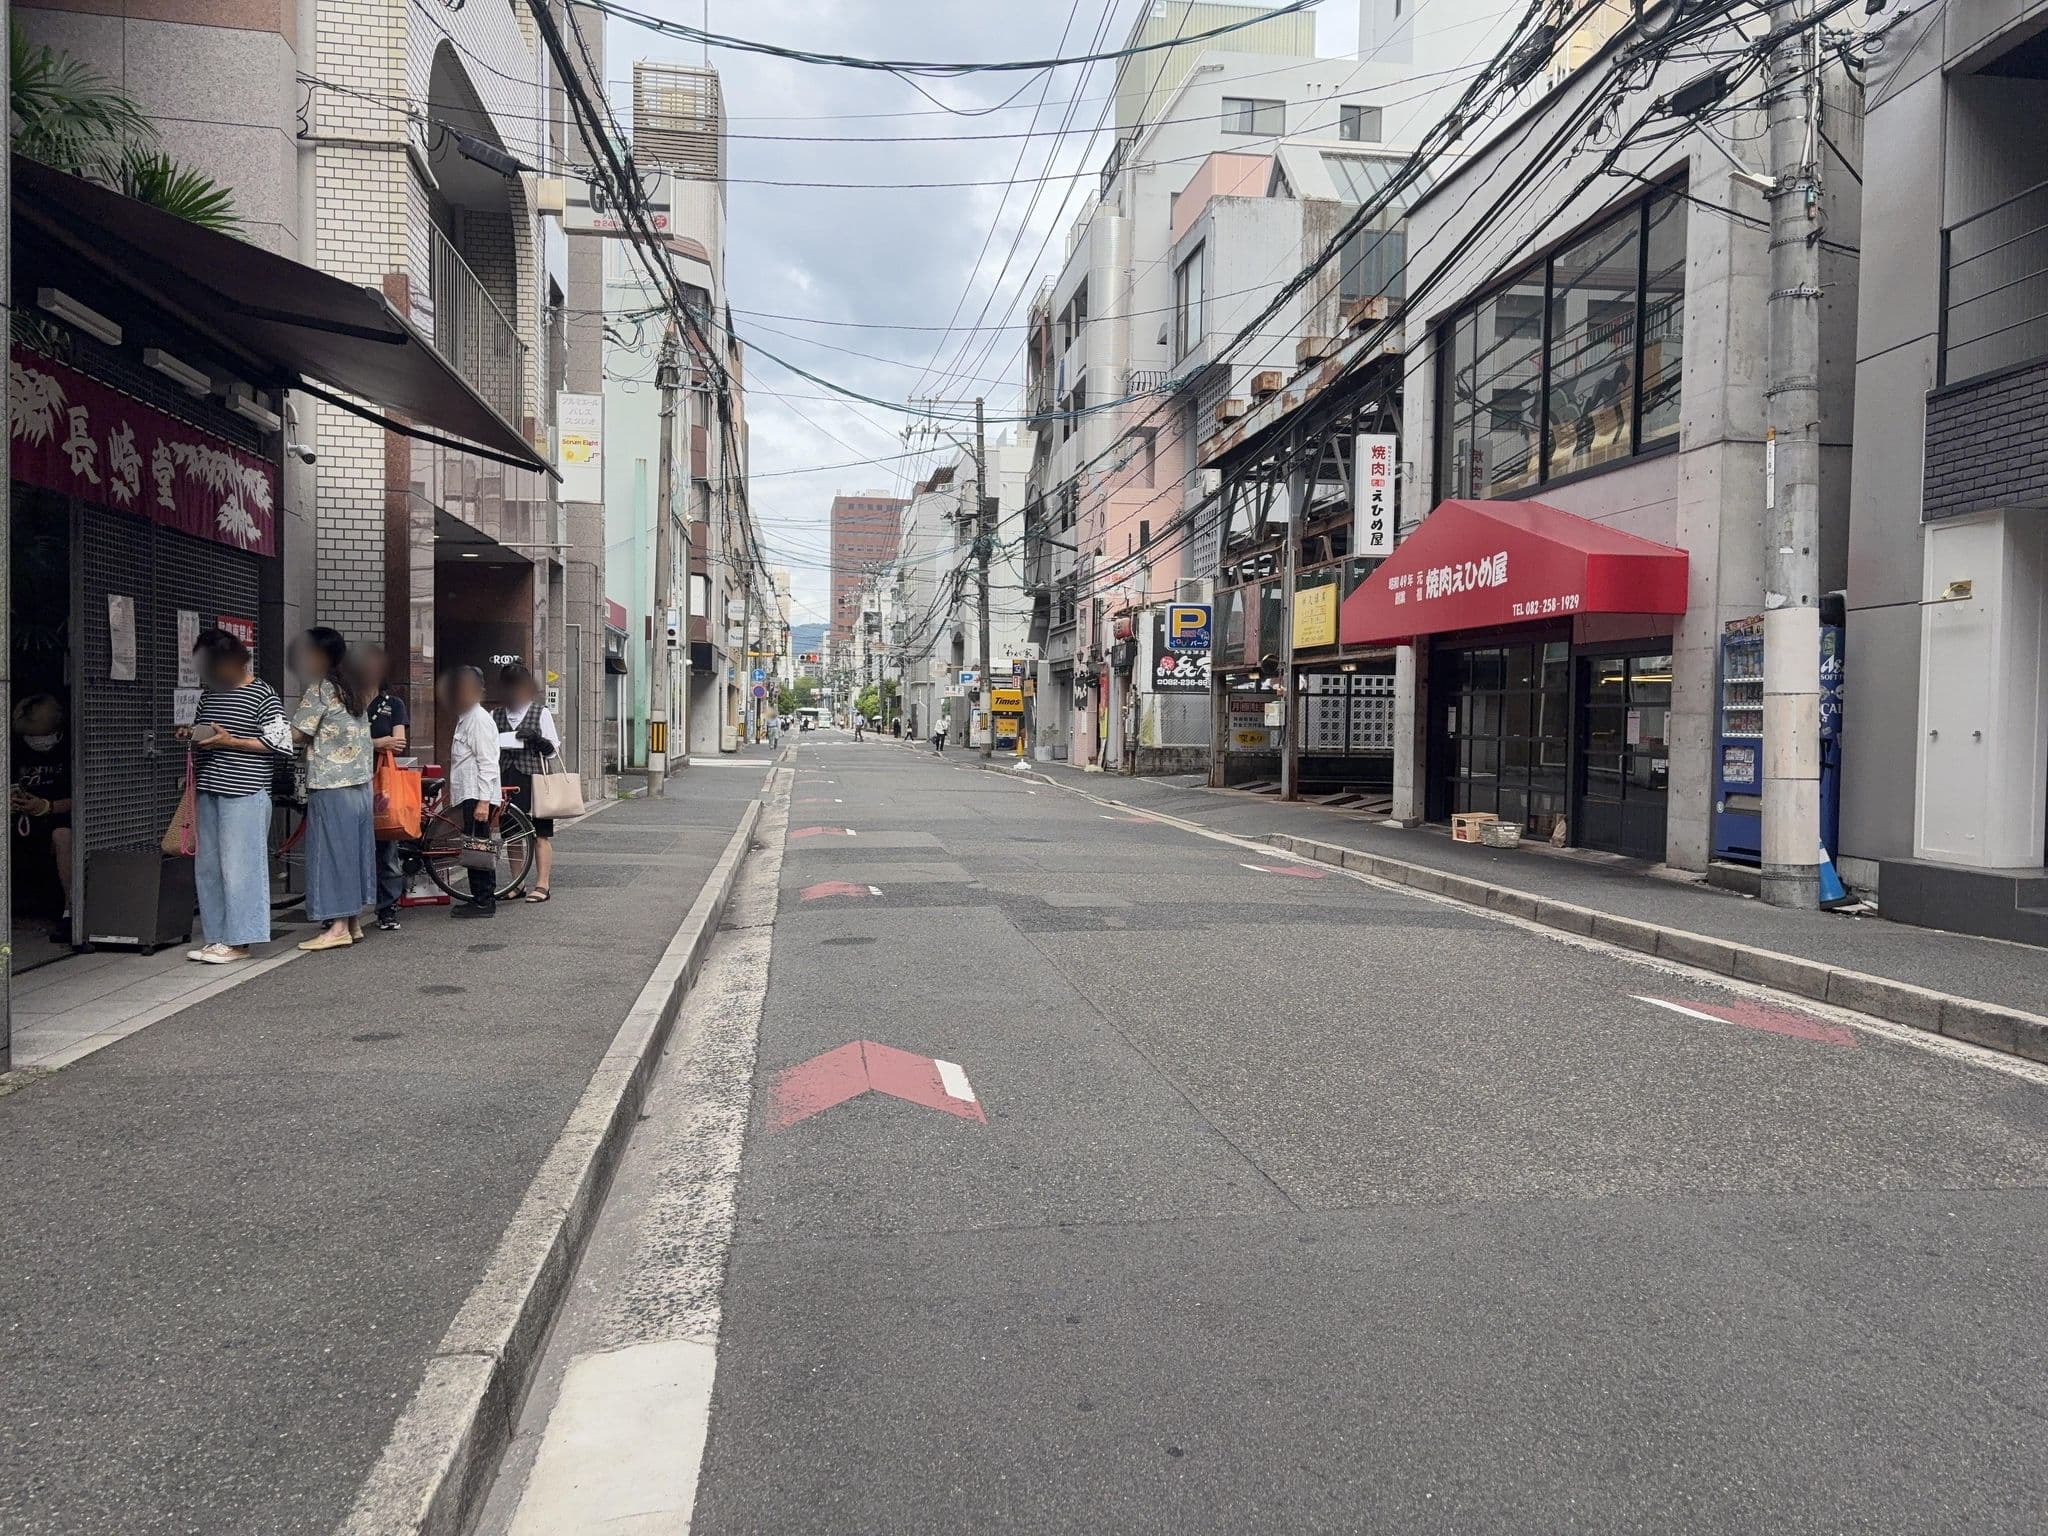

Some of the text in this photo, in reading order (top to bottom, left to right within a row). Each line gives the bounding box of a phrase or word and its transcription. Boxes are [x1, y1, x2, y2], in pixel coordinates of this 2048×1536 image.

[582, 439, 599, 447] Eight
[1370, 490, 1384, 546] えひめ屋
[1426, 551, 1508, 599] 焼肉えひめ屋
[1512, 594, 1580, 617] TEL 082-258-1929
[1172, 608, 1207, 638] P
[960, 673, 974, 684] P
[994, 696, 1021, 706] Times
